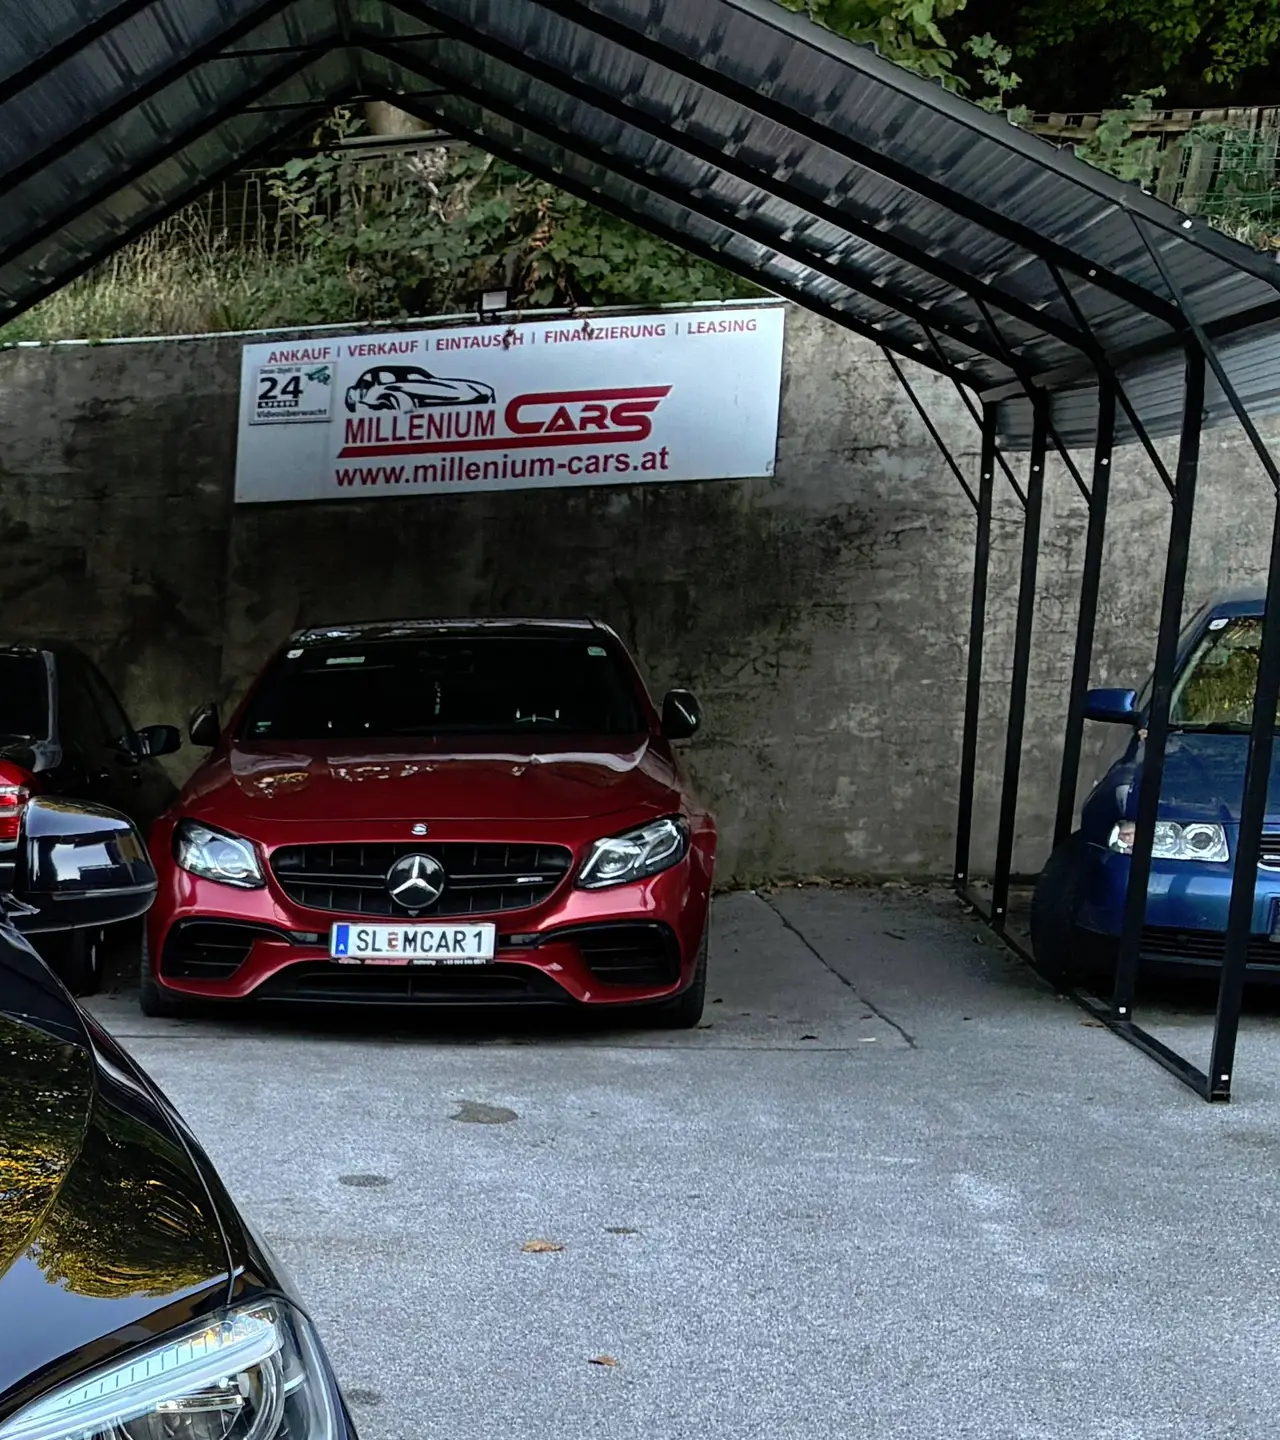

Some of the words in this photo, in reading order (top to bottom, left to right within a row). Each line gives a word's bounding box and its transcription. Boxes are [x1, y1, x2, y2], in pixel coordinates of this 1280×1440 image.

[267, 346, 331, 364] ANKAUF
[347, 340, 420, 358] VERKAUF
[435, 331, 525, 352] EINTAUSCH
[544, 322, 667, 345] FINANZIERUNG
[686, 318, 758, 335] LEASING
[258, 375, 304, 401] 24
[344, 409, 496, 446] MILLENIUM
[504, 385, 673, 440] CARS
[334, 445, 670, 488] www.millenium-cars.at
[356, 929, 383, 953] SL
